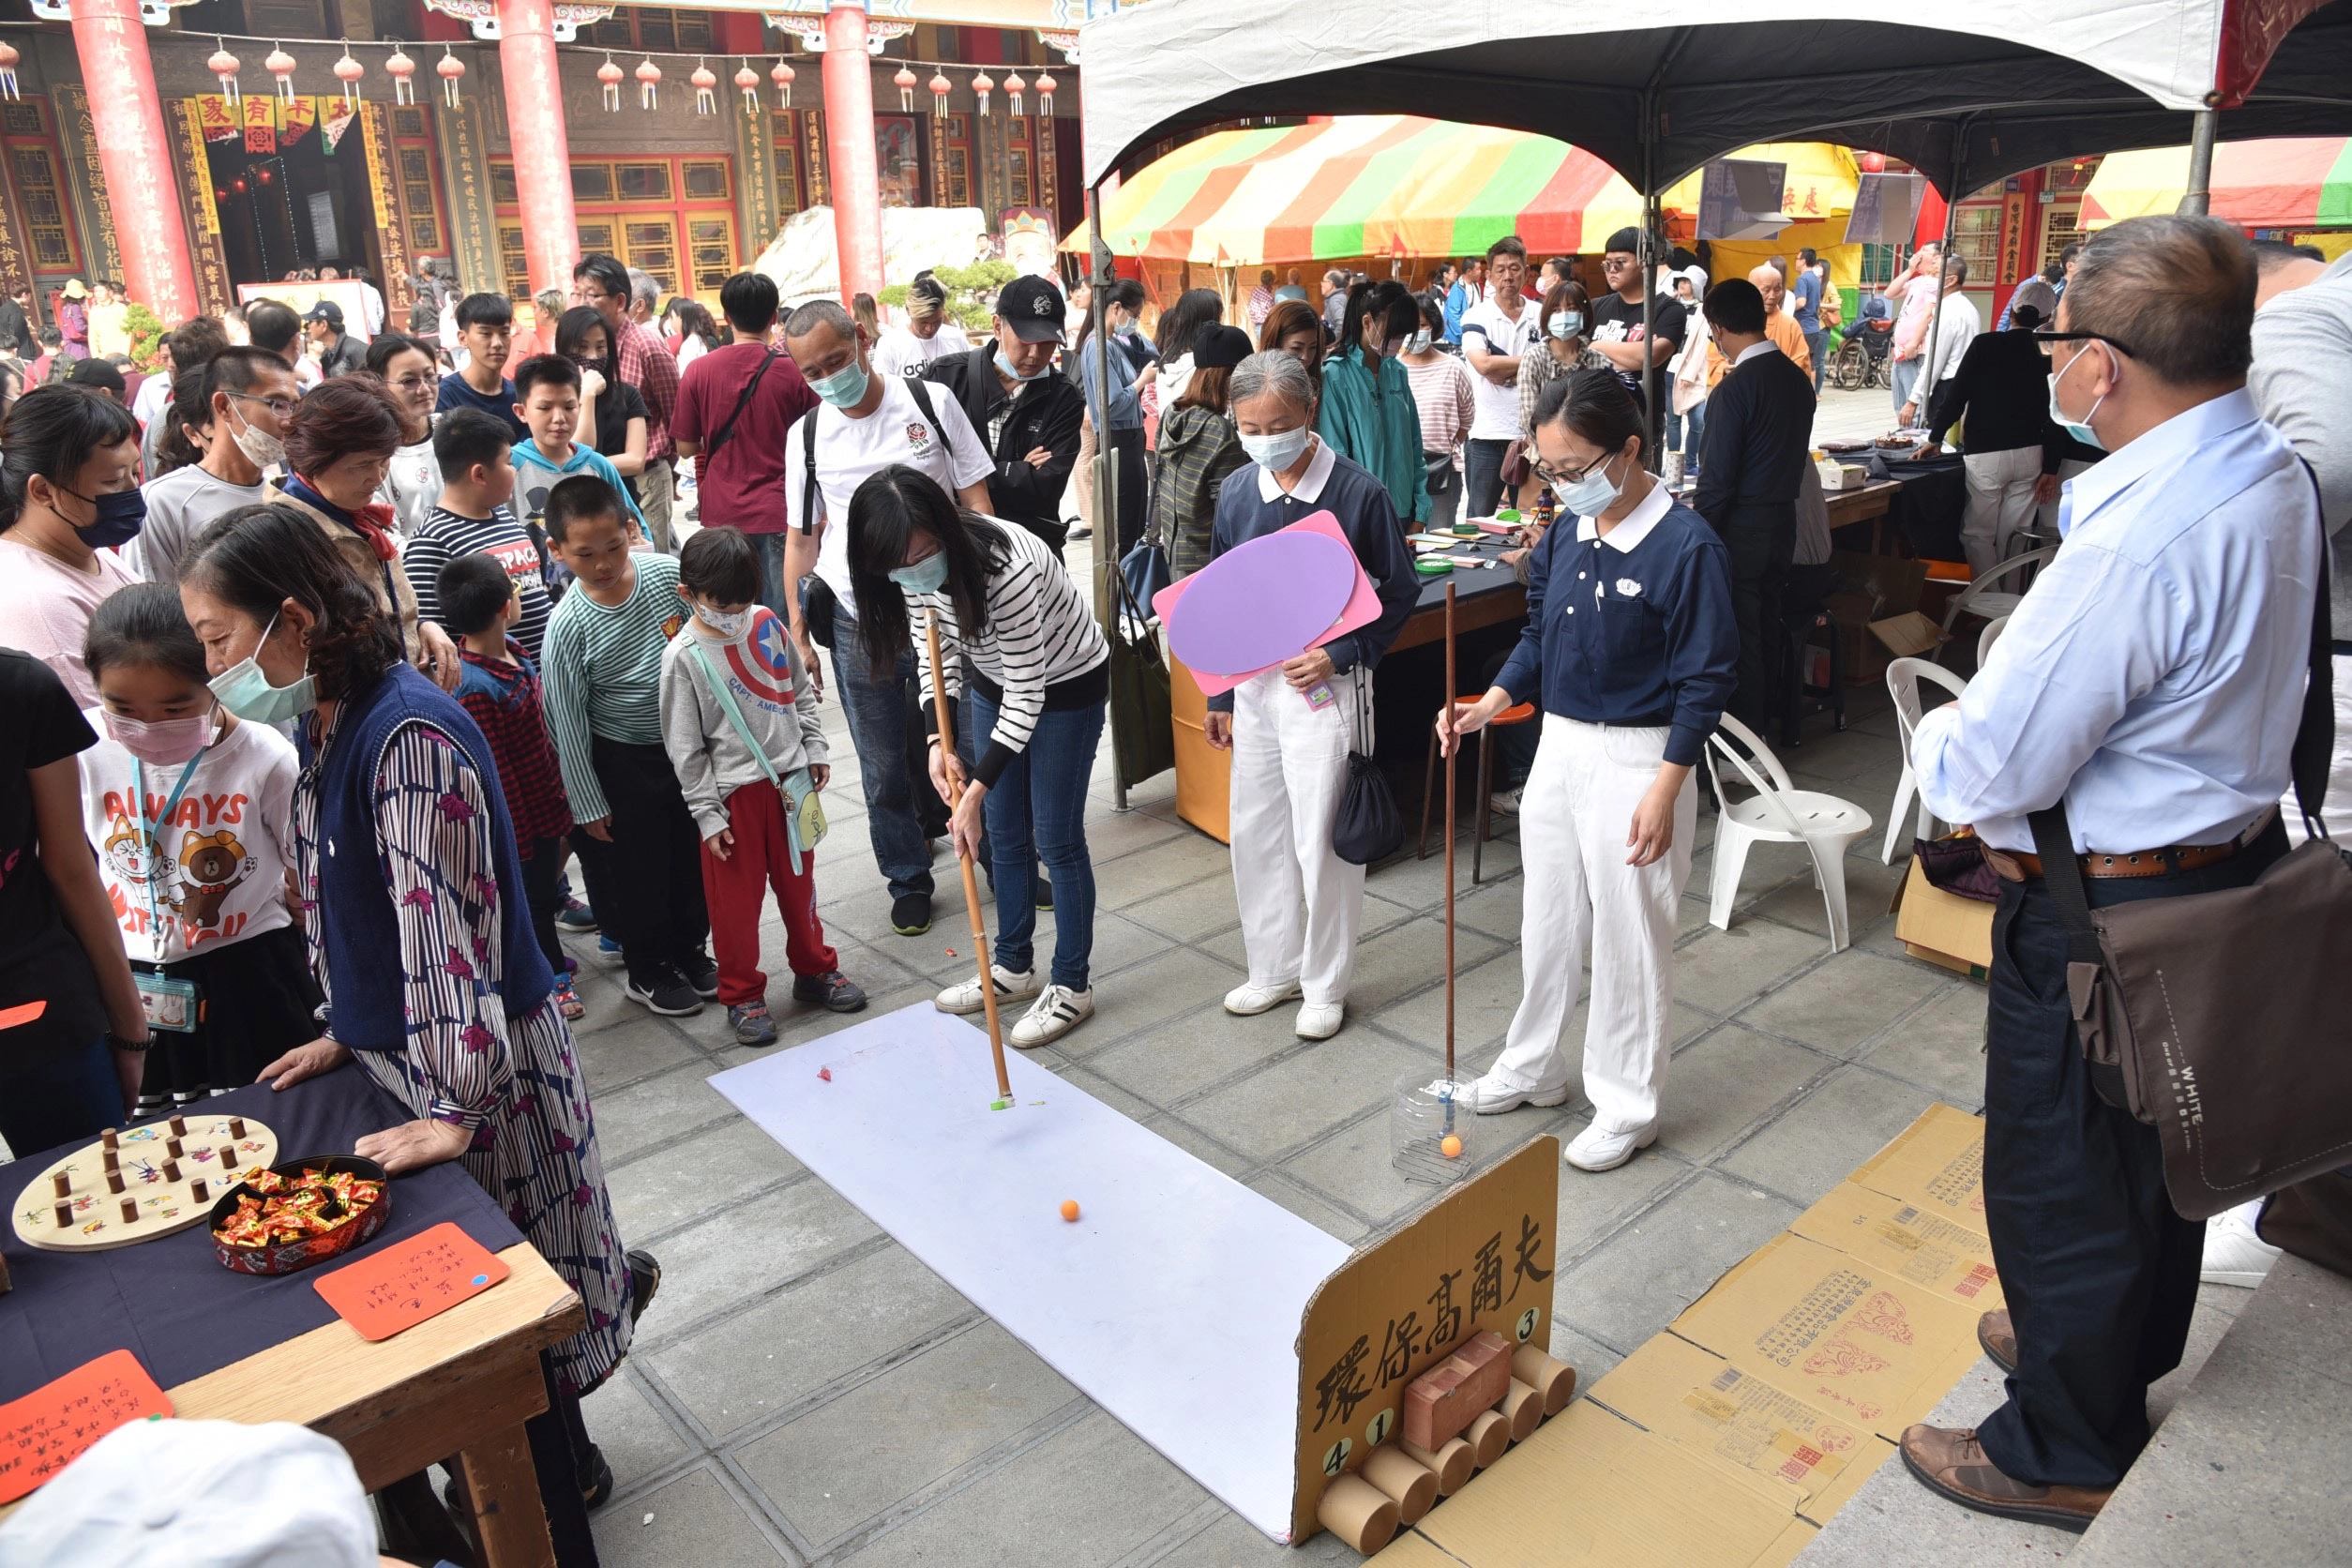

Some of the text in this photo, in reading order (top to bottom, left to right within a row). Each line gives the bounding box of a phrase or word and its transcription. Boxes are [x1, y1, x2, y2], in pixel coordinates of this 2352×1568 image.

[729, 677, 752, 703] CAPT.
[103, 787, 249, 830] ALWAYS
[2181, 1065, 2204, 1124] WHITE
[1314, 1214, 1553, 1433] 環保高爾夫
[1519, 1317, 1535, 1339] 3
[1376, 1418, 1385, 1440] 1
[1324, 1440, 1349, 1472] 4
